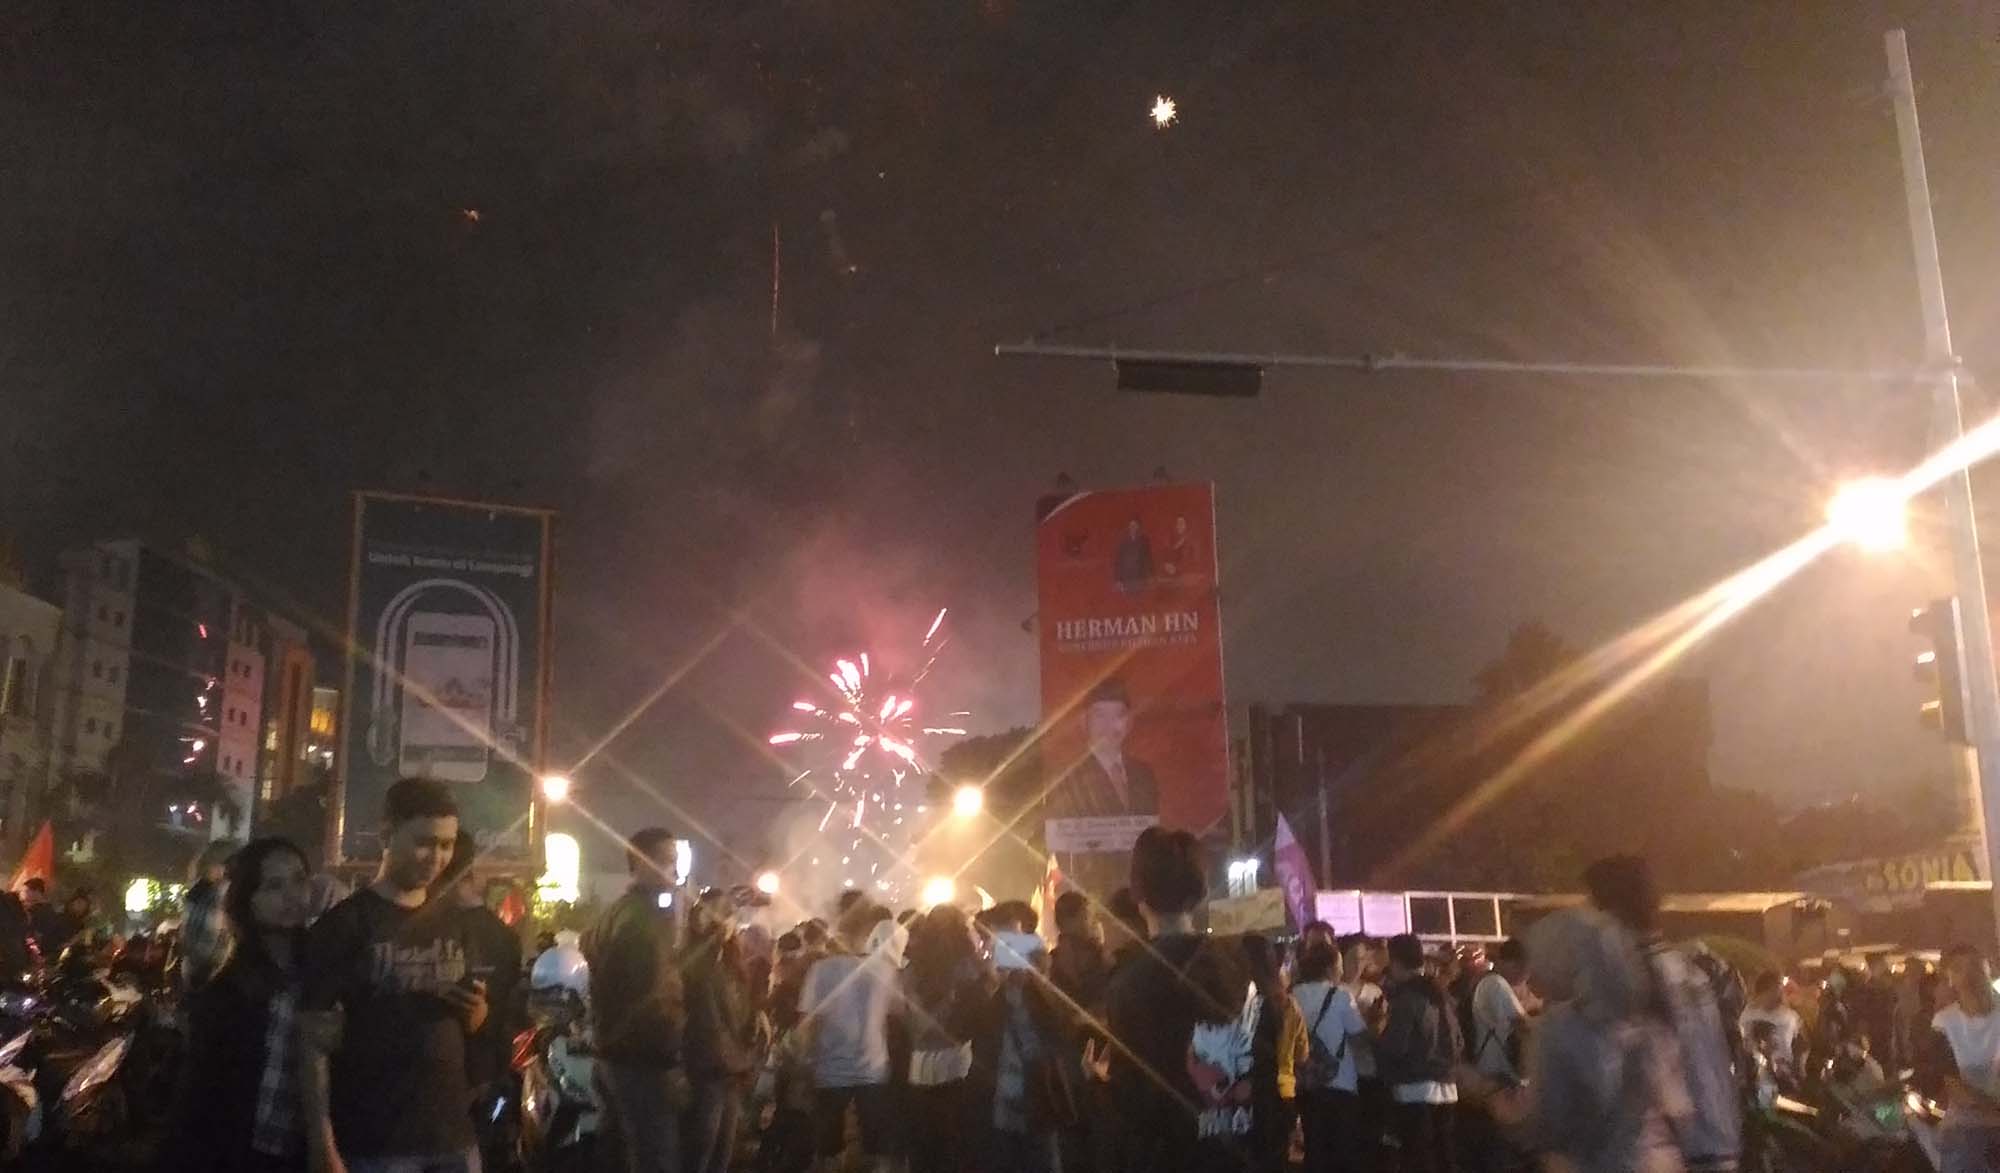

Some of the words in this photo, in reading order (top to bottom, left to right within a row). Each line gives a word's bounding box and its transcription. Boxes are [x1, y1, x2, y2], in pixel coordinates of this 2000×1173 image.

[1056, 615, 1156, 640] HERMAN
[1164, 611, 1199, 632] HN
[1883, 852, 1974, 889] SONIA
